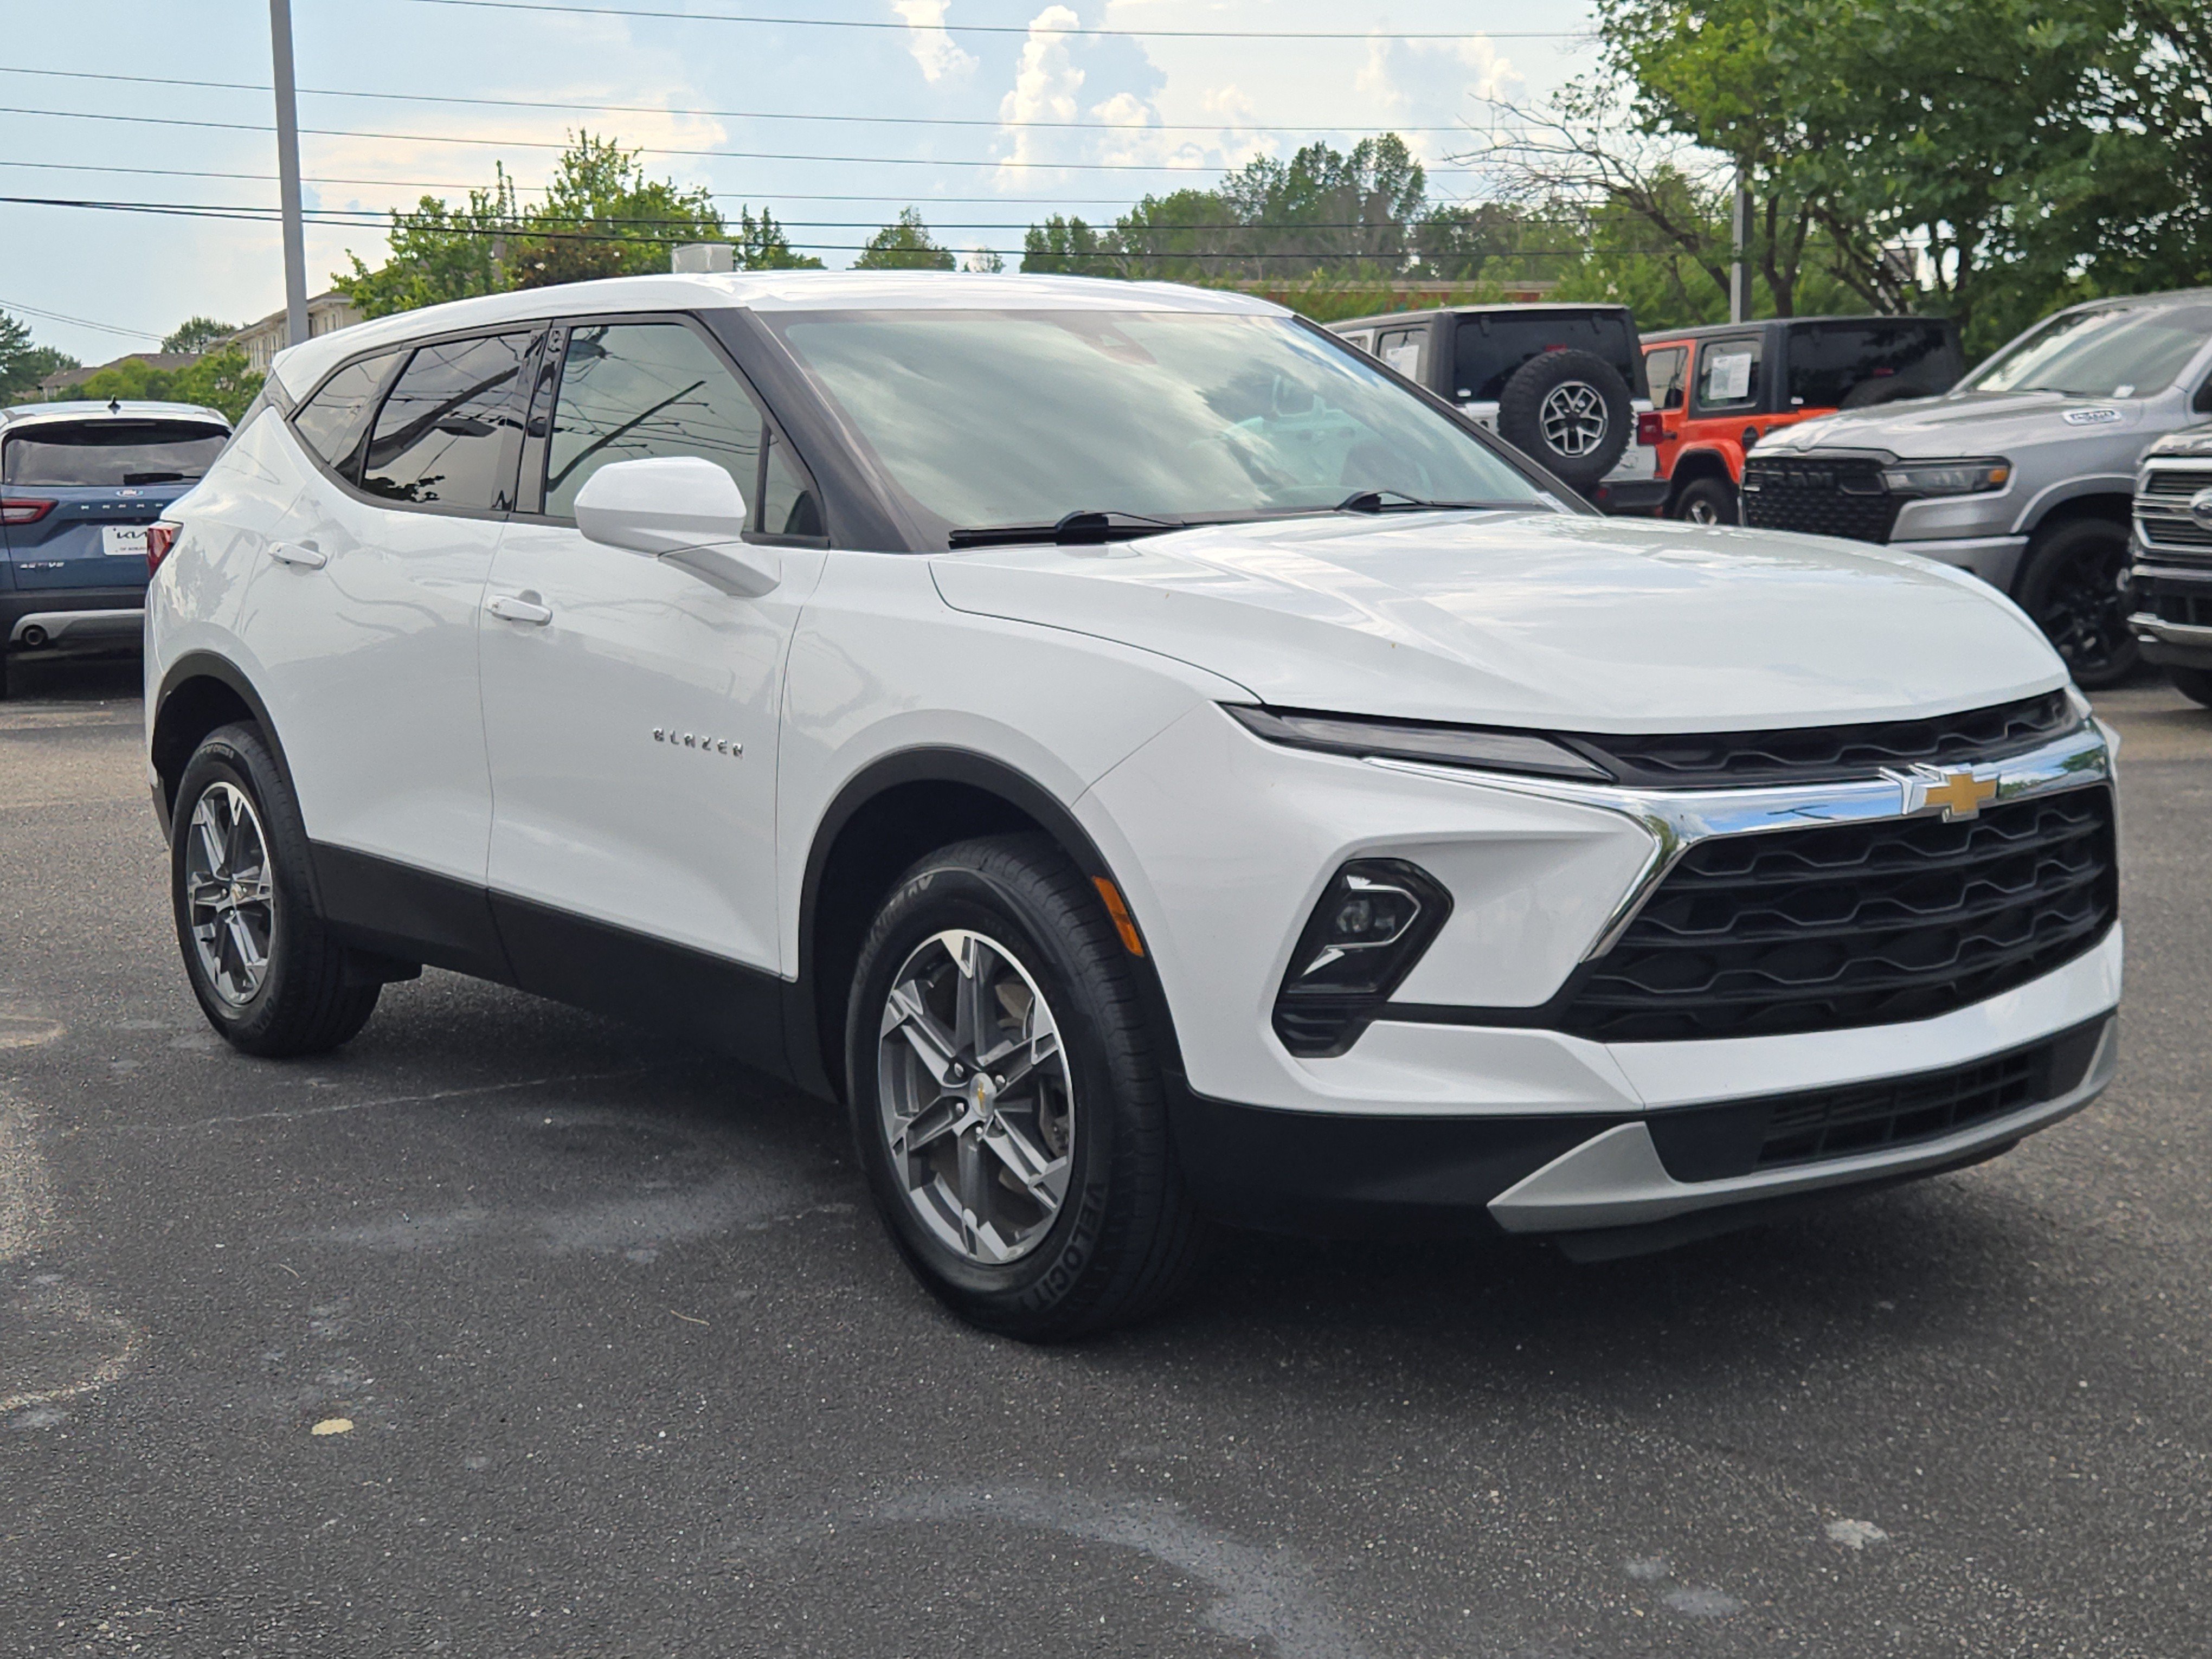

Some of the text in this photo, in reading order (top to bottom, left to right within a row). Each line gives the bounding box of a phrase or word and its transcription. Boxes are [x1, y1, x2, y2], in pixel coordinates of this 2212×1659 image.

[1764, 470, 1834, 487] RAM
[653, 727, 743, 759] BLAZER
[1018, 1182, 1109, 1313] VELOCITY
